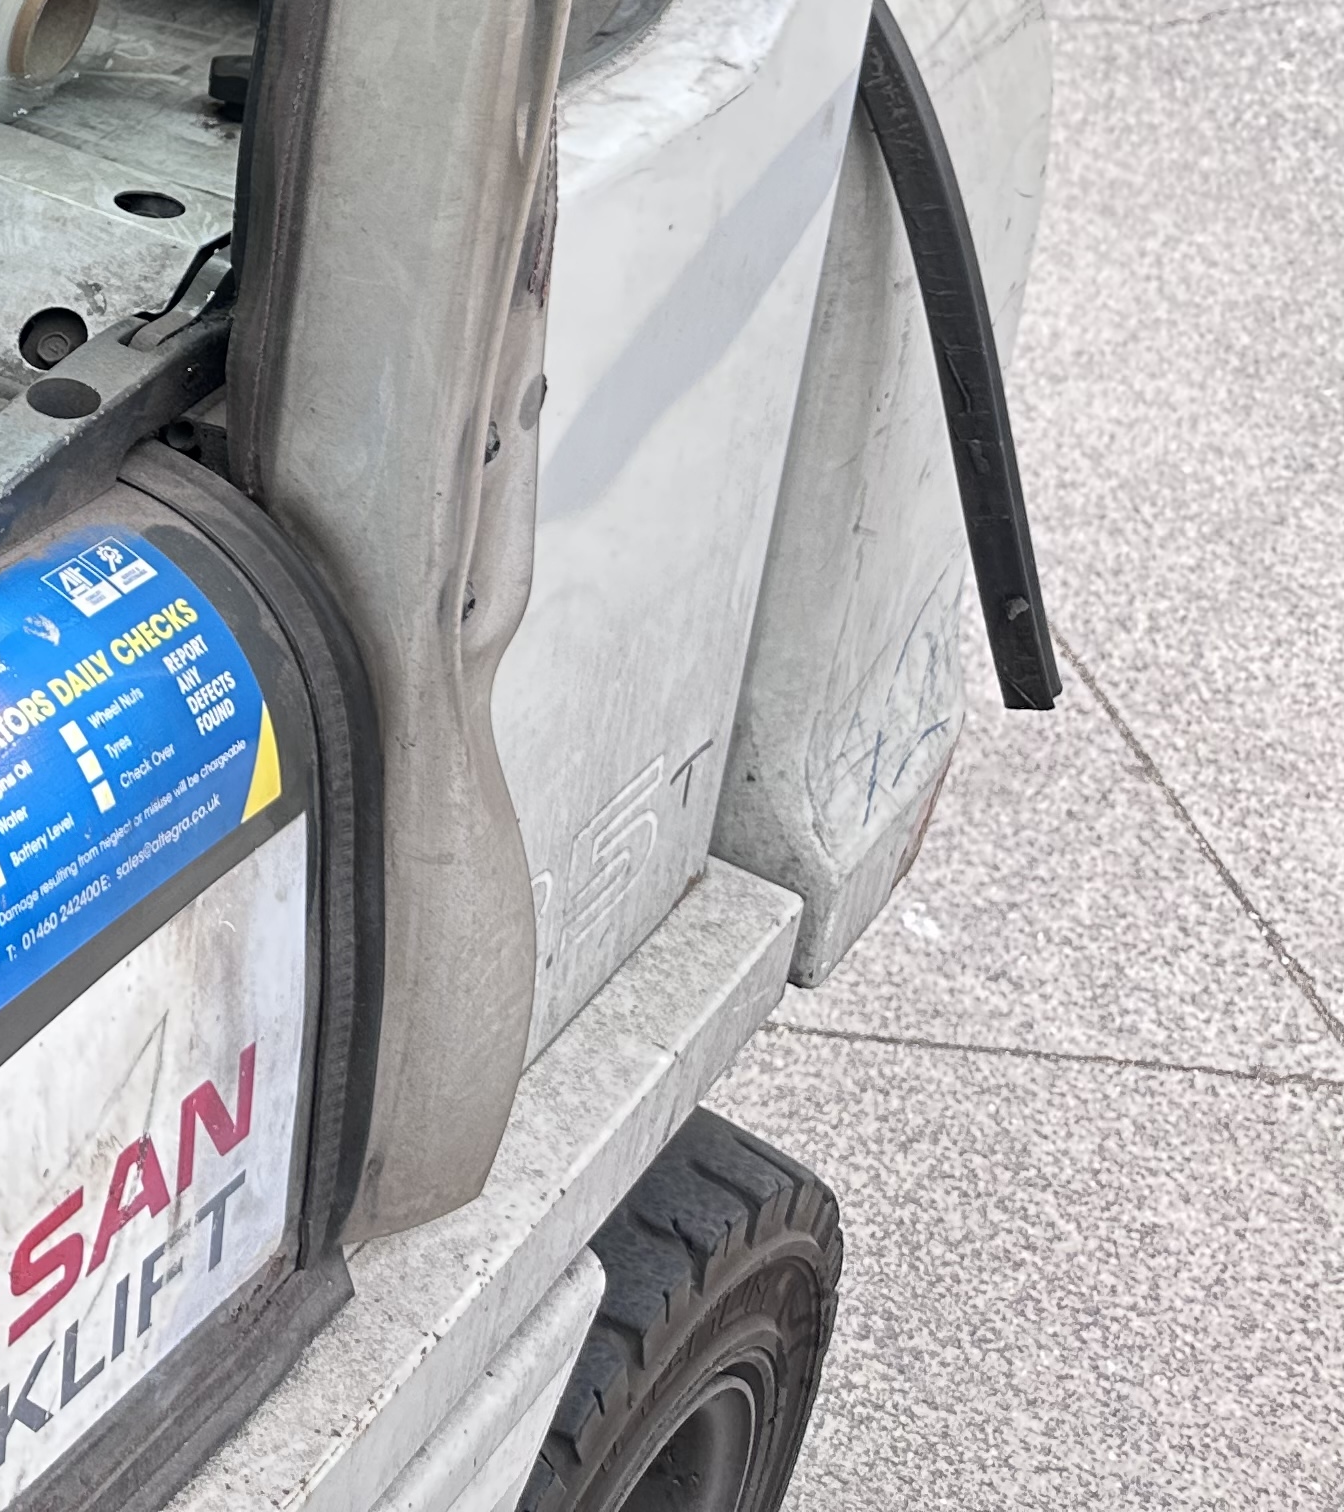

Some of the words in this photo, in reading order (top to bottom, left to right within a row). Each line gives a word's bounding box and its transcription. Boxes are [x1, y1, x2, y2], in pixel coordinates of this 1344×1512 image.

[46, 649, 114, 708] DAILY
[109, 597, 199, 666] CHECKS
[162, 634, 209, 675] REPORT
[176, 665, 202, 695] ANY
[185, 670, 237, 716] DEFECTS
[86, 699, 123, 730] Wheel
[118, 687, 145, 710] Nuts
[195, 697, 236, 737] FOUND
[104, 734, 133, 760] Tyres
[119, 758, 153, 788] Check
[151, 743, 176, 766] Over
[13, 759, 34, 780] Oil
[9, 833, 49, 868] Battery
[46, 811, 75, 842] Level
[39, 861, 79, 897] resulting
[77, 845, 100, 868] from
[98, 818, 133, 852] neglect
[133, 812, 144, 827] or
[143, 792, 173, 820] misuse
[172, 779, 188, 798] will
[186, 772, 200, 788] be
[200, 739, 247, 779] chargeable
[5, 943, 18, 962] T:
[21, 911, 58, 951] 01460
[59, 879, 101, 923] 242400
